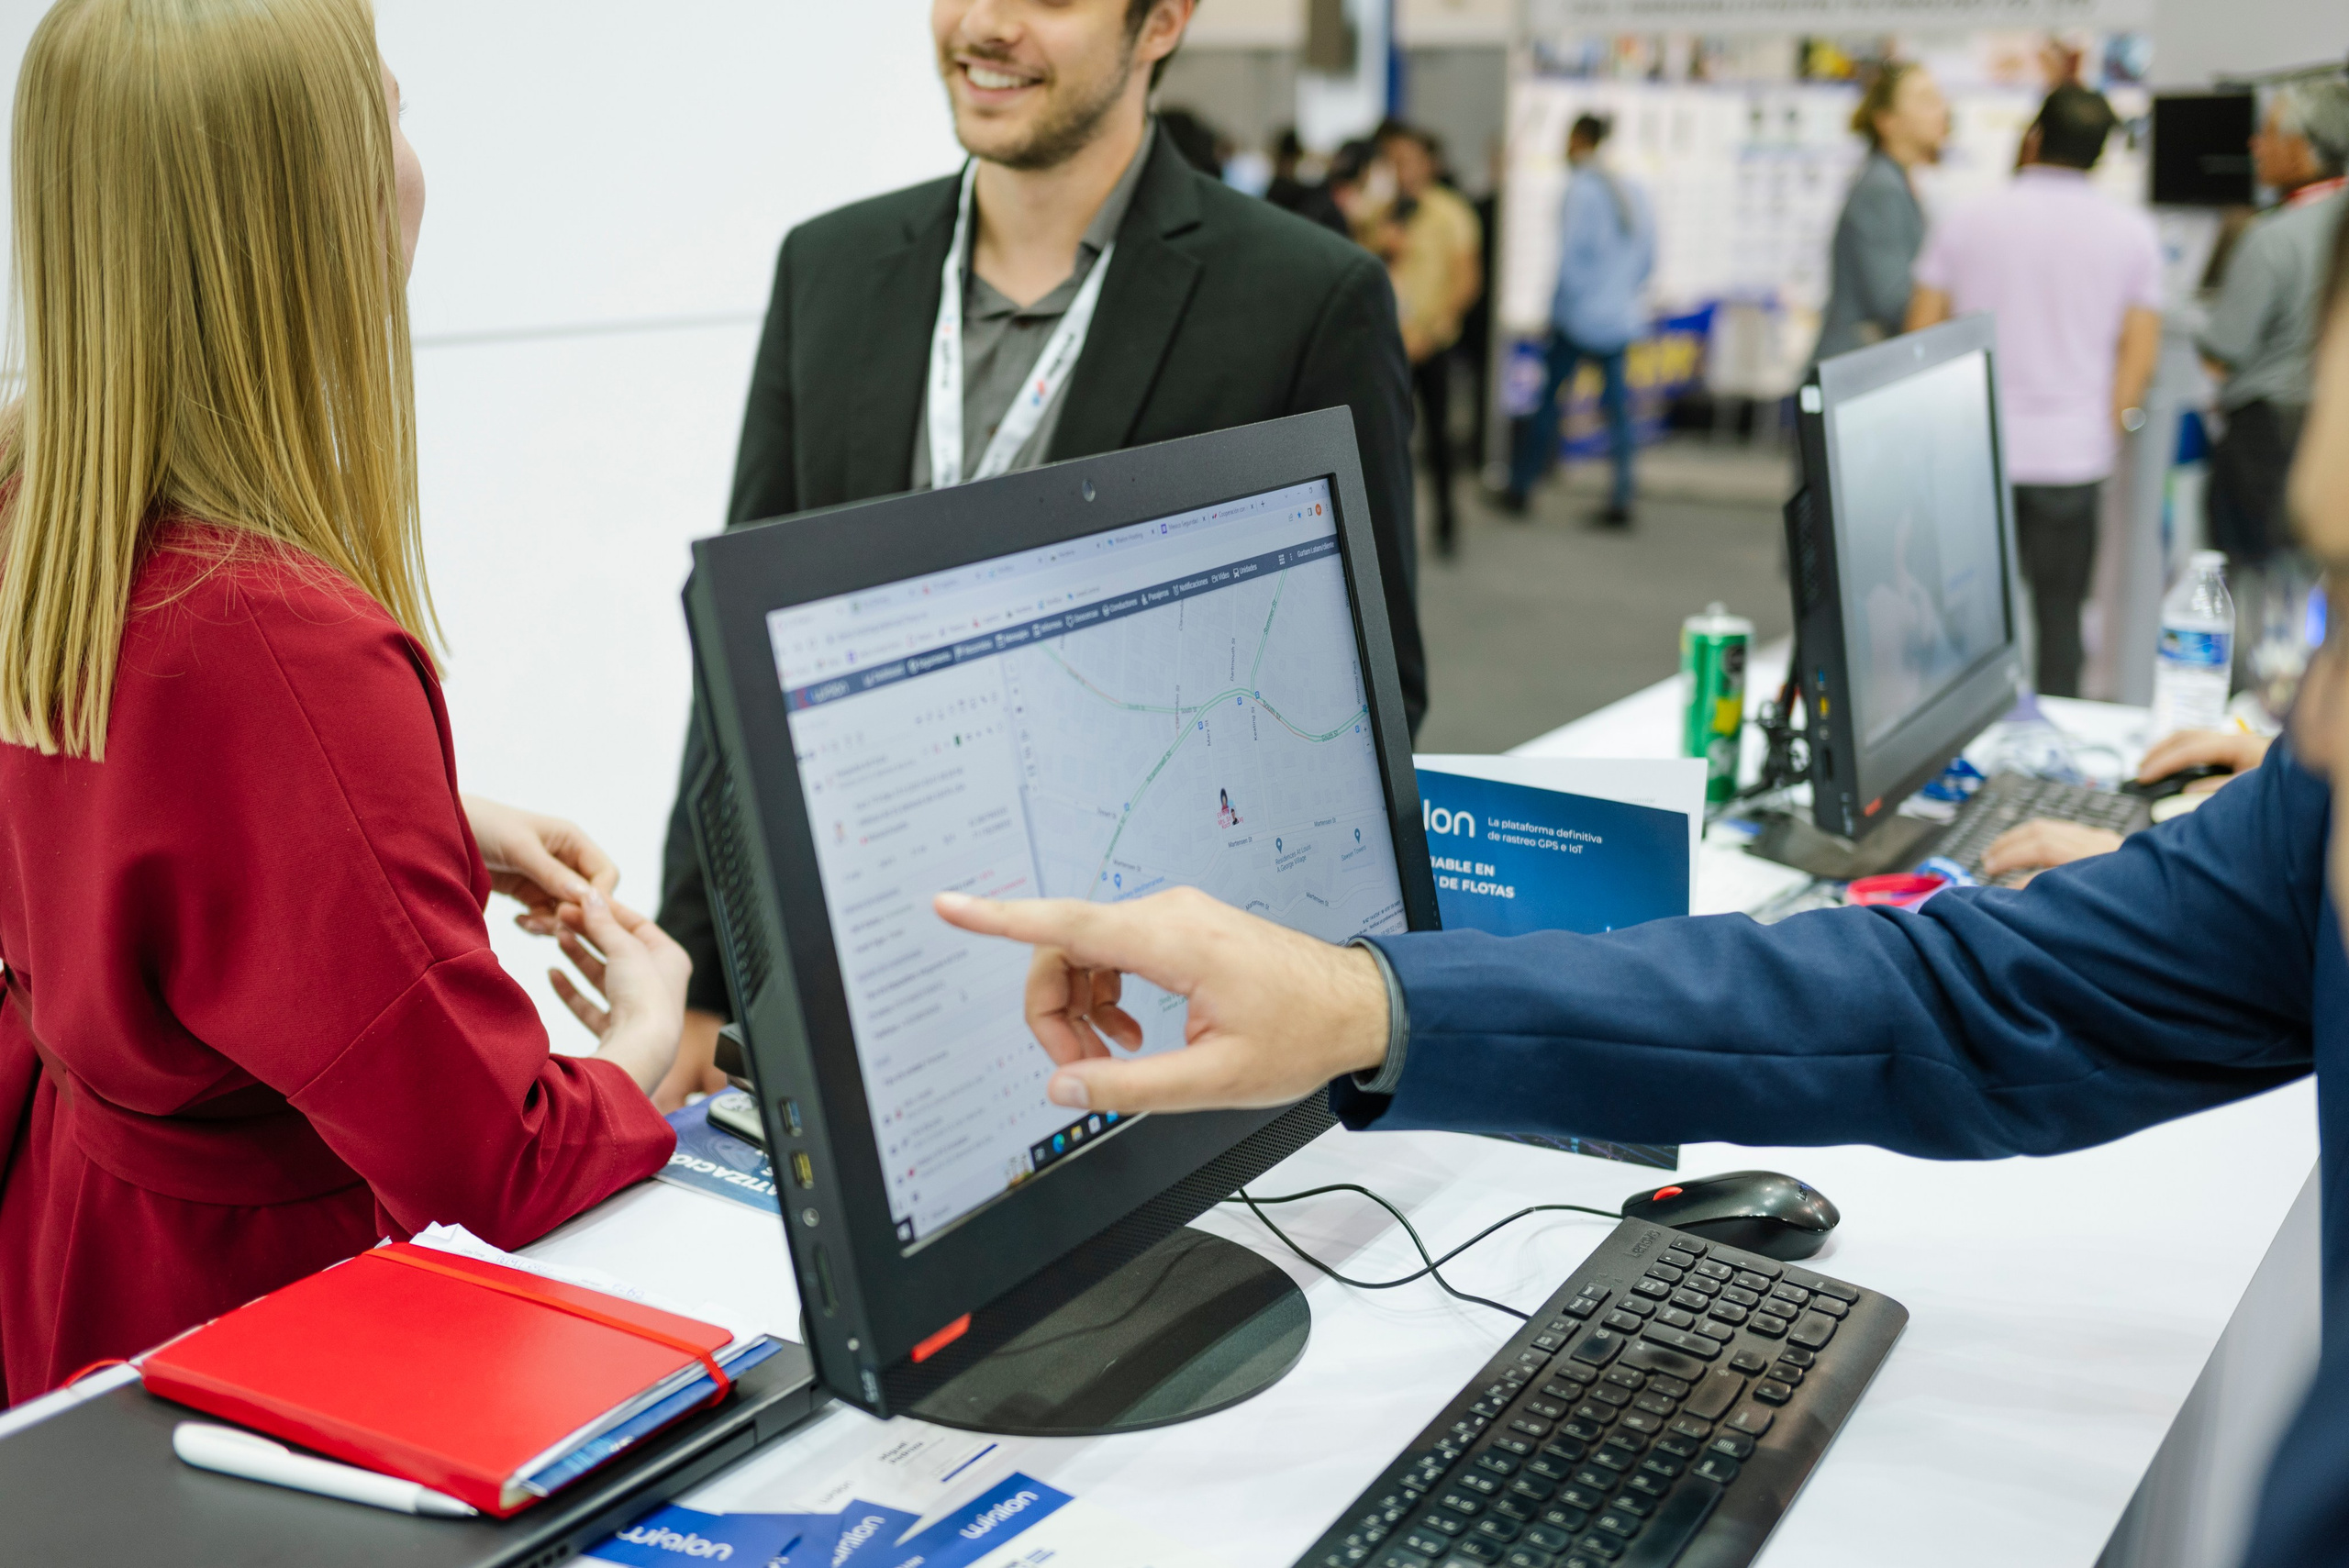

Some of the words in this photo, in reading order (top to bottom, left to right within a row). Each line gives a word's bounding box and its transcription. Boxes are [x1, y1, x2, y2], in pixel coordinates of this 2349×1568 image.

[1239, 563, 1258, 574] Unidades
[1179, 578, 1208, 592] Notificaciones
[1148, 589, 1170, 602] Pasajeros
[1264, 607, 1275, 634] Summer
[1487, 817, 1499, 827] La
[1501, 819, 1554, 836] plataforma
[1556, 828, 1603, 844] definitiva
[1228, 839, 1248, 848] Martensen
[1487, 830, 1500, 840] de
[1502, 834, 1536, 847] rastreo
[1537, 839, 1559, 851] GPS
[1560, 843, 1567, 852] e
[1275, 851, 1296, 865] Residences
[1294, 854, 1307, 866] Village
[1430, 855, 1472, 873] IABLE
[1475, 862, 1496, 877] EN
[1439, 875, 1459, 890] DE
[1462, 878, 1515, 899] FLOTAS
[1245, 898, 1264, 911] Martensen
[1306, 892, 1324, 905] Martensen
